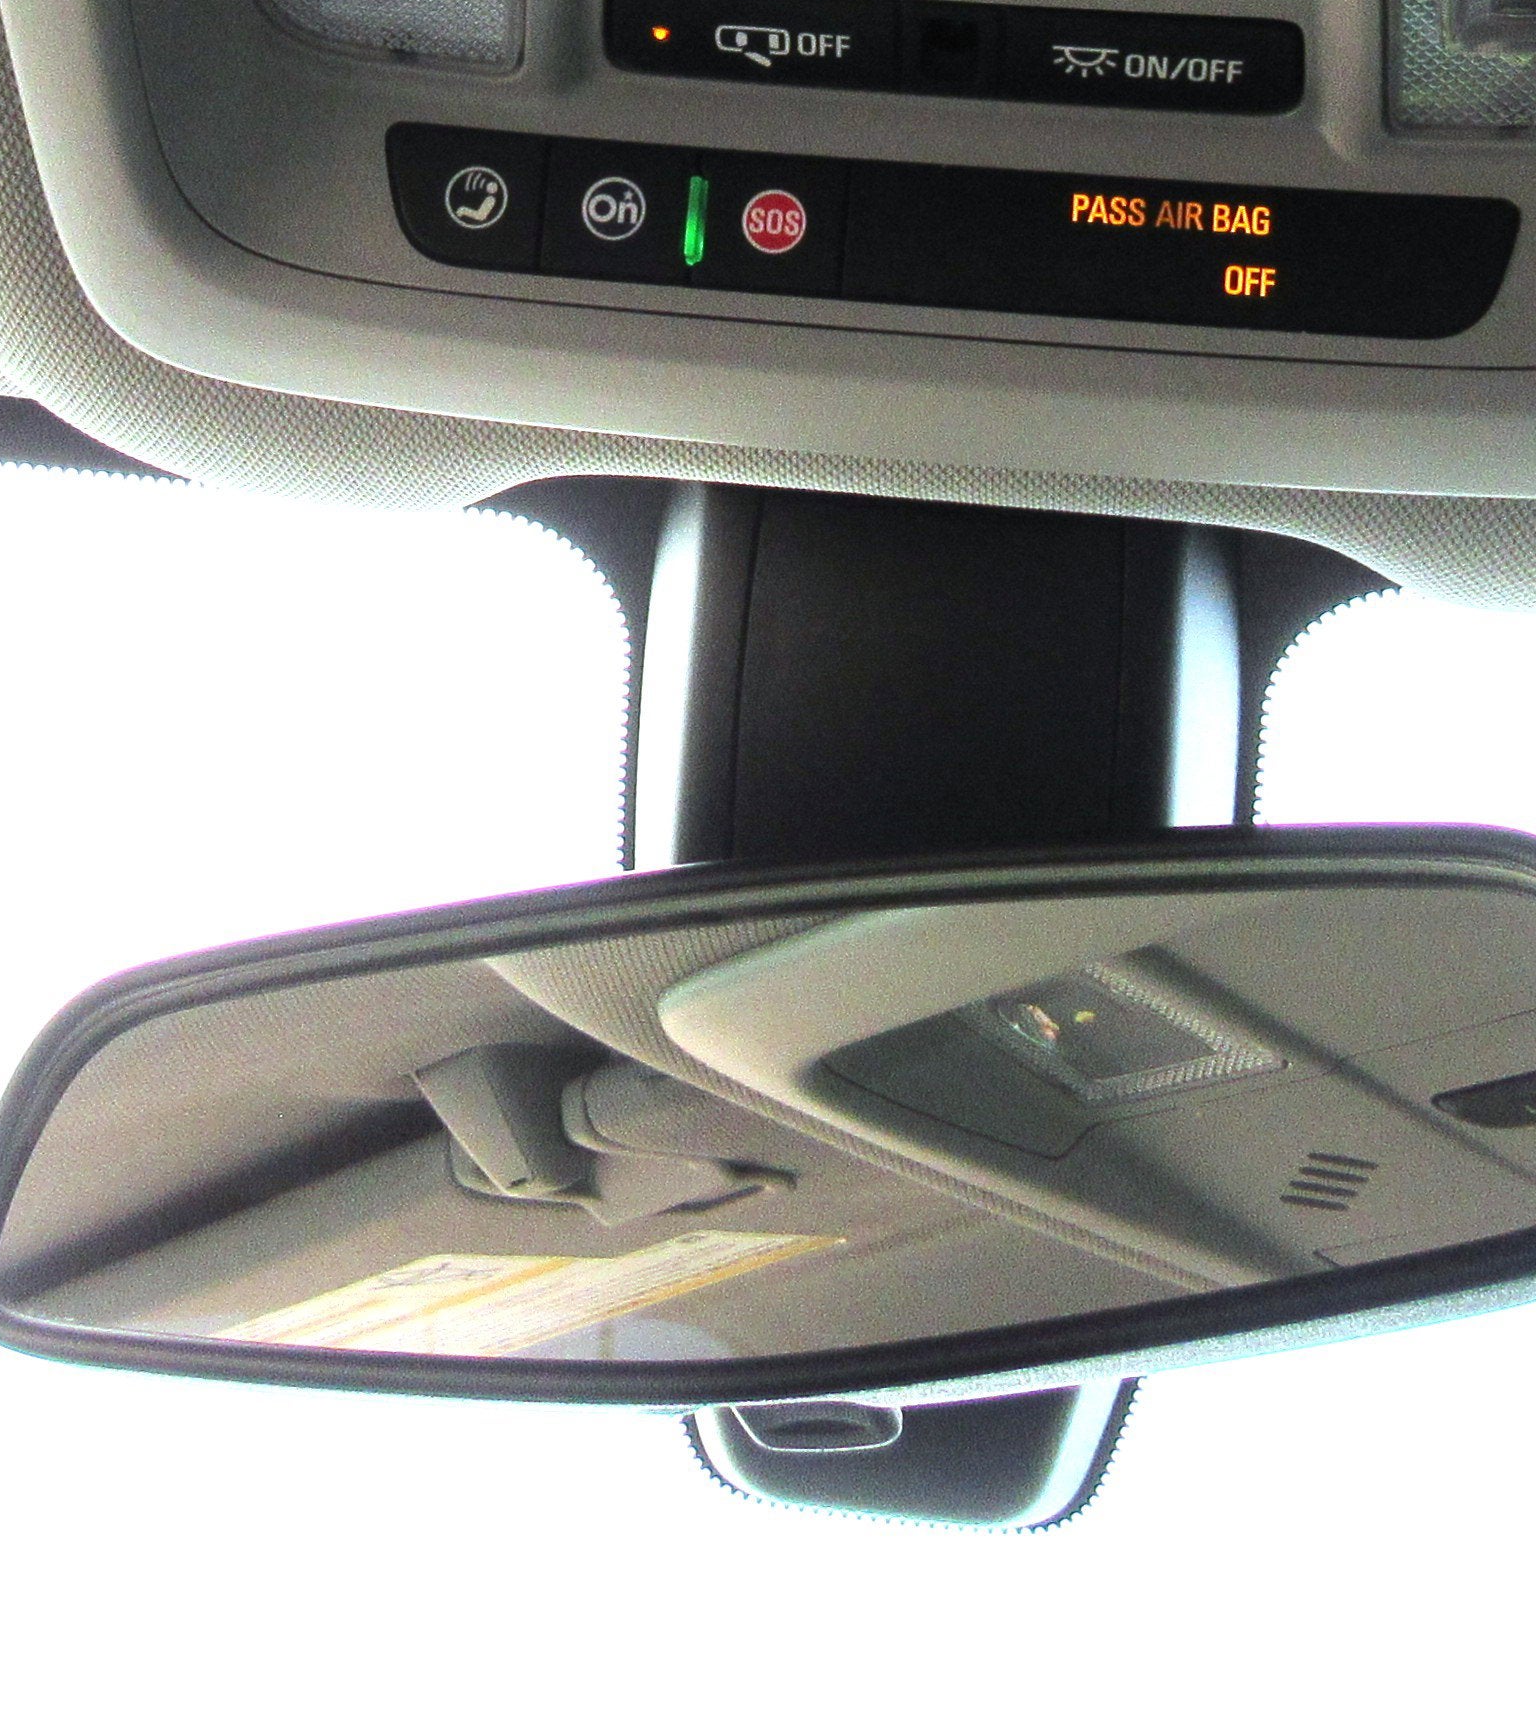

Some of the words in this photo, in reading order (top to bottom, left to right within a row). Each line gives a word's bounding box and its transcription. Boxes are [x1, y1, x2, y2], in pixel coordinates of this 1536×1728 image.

[797, 32, 851, 58] OFF
[1124, 54, 1244, 84] ON/OFF
[748, 206, 802, 237] SOS
[1071, 193, 1146, 227] PASS
[1155, 200, 1204, 231] AIR
[1213, 203, 1271, 236] BAG
[1223, 265, 1277, 298] OFF
